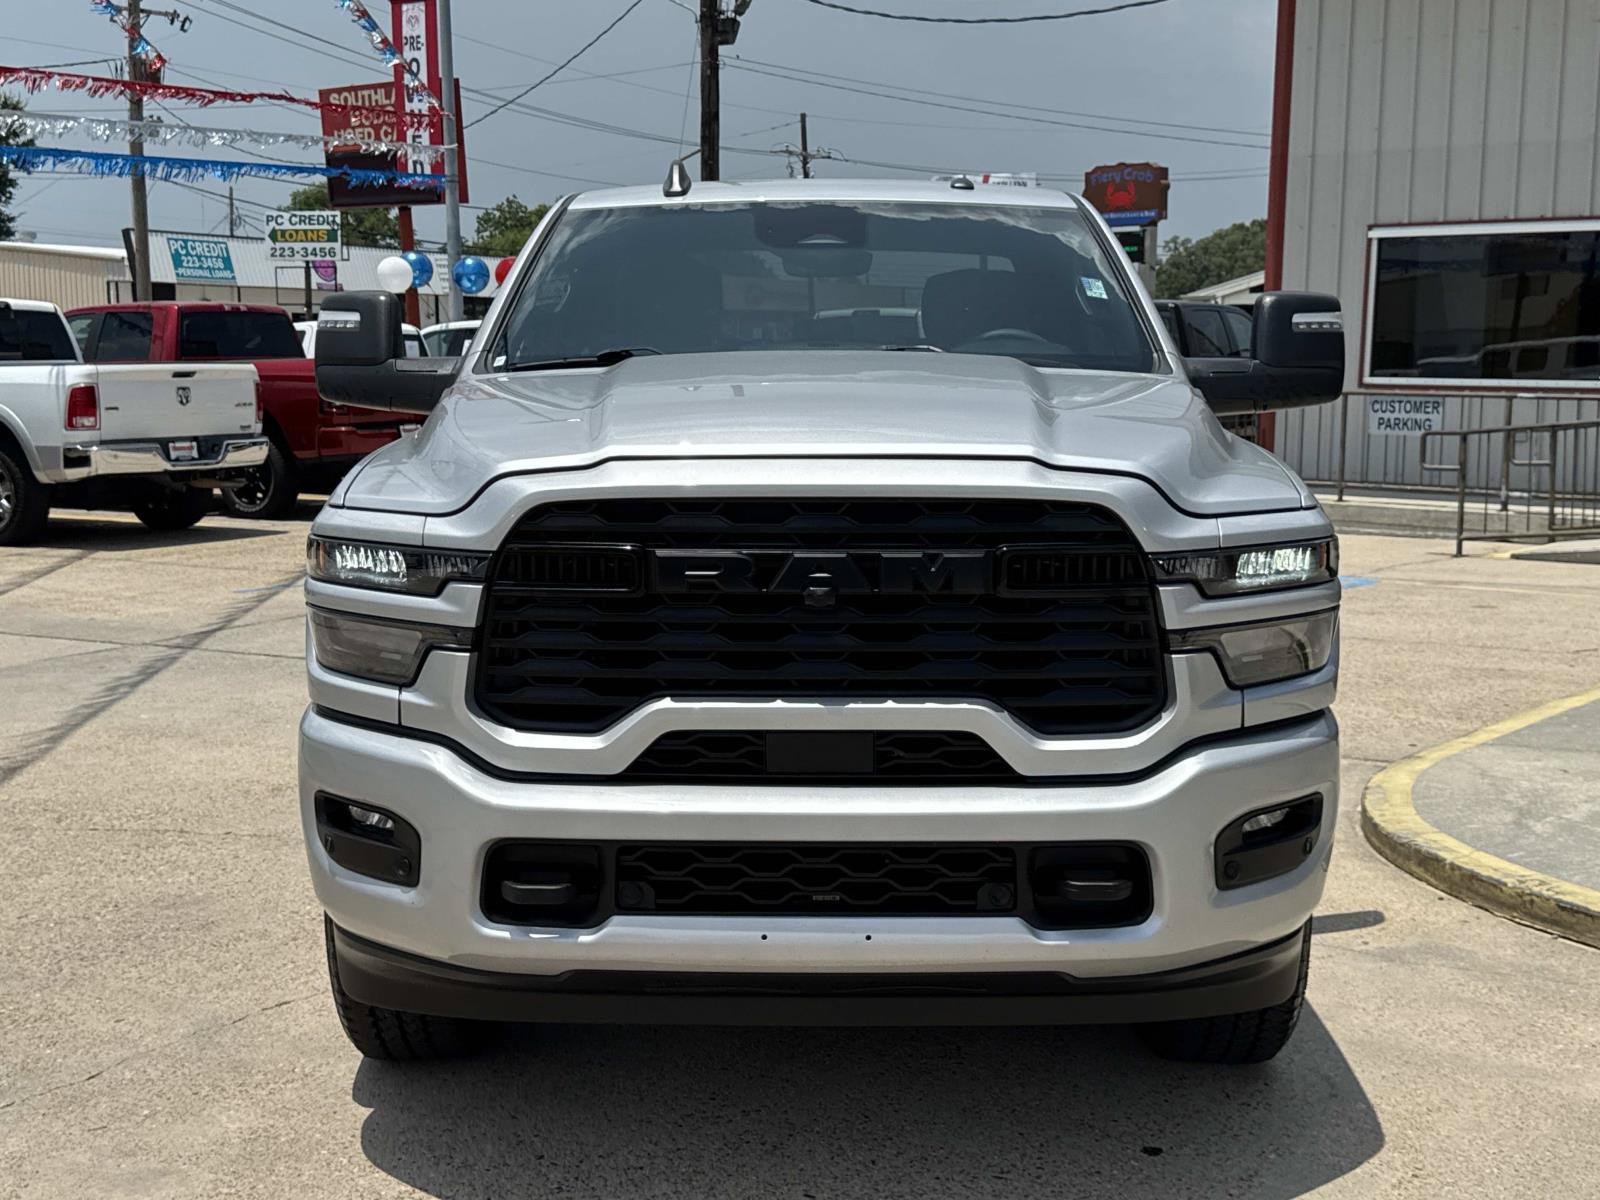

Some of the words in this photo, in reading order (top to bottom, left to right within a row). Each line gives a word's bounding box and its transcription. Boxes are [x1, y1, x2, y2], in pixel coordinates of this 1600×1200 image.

[266, 214, 284, 226] PC
[288, 214, 339, 226] CREDIT
[276, 230, 328, 241] LOANS
[169, 240, 187, 255] PC
[187, 241, 228, 257] CREDIT
[1371, 399, 1440, 415] CUSTOMER
[1377, 417, 1432, 431] PARKING
[655, 549, 986, 595] RAM
